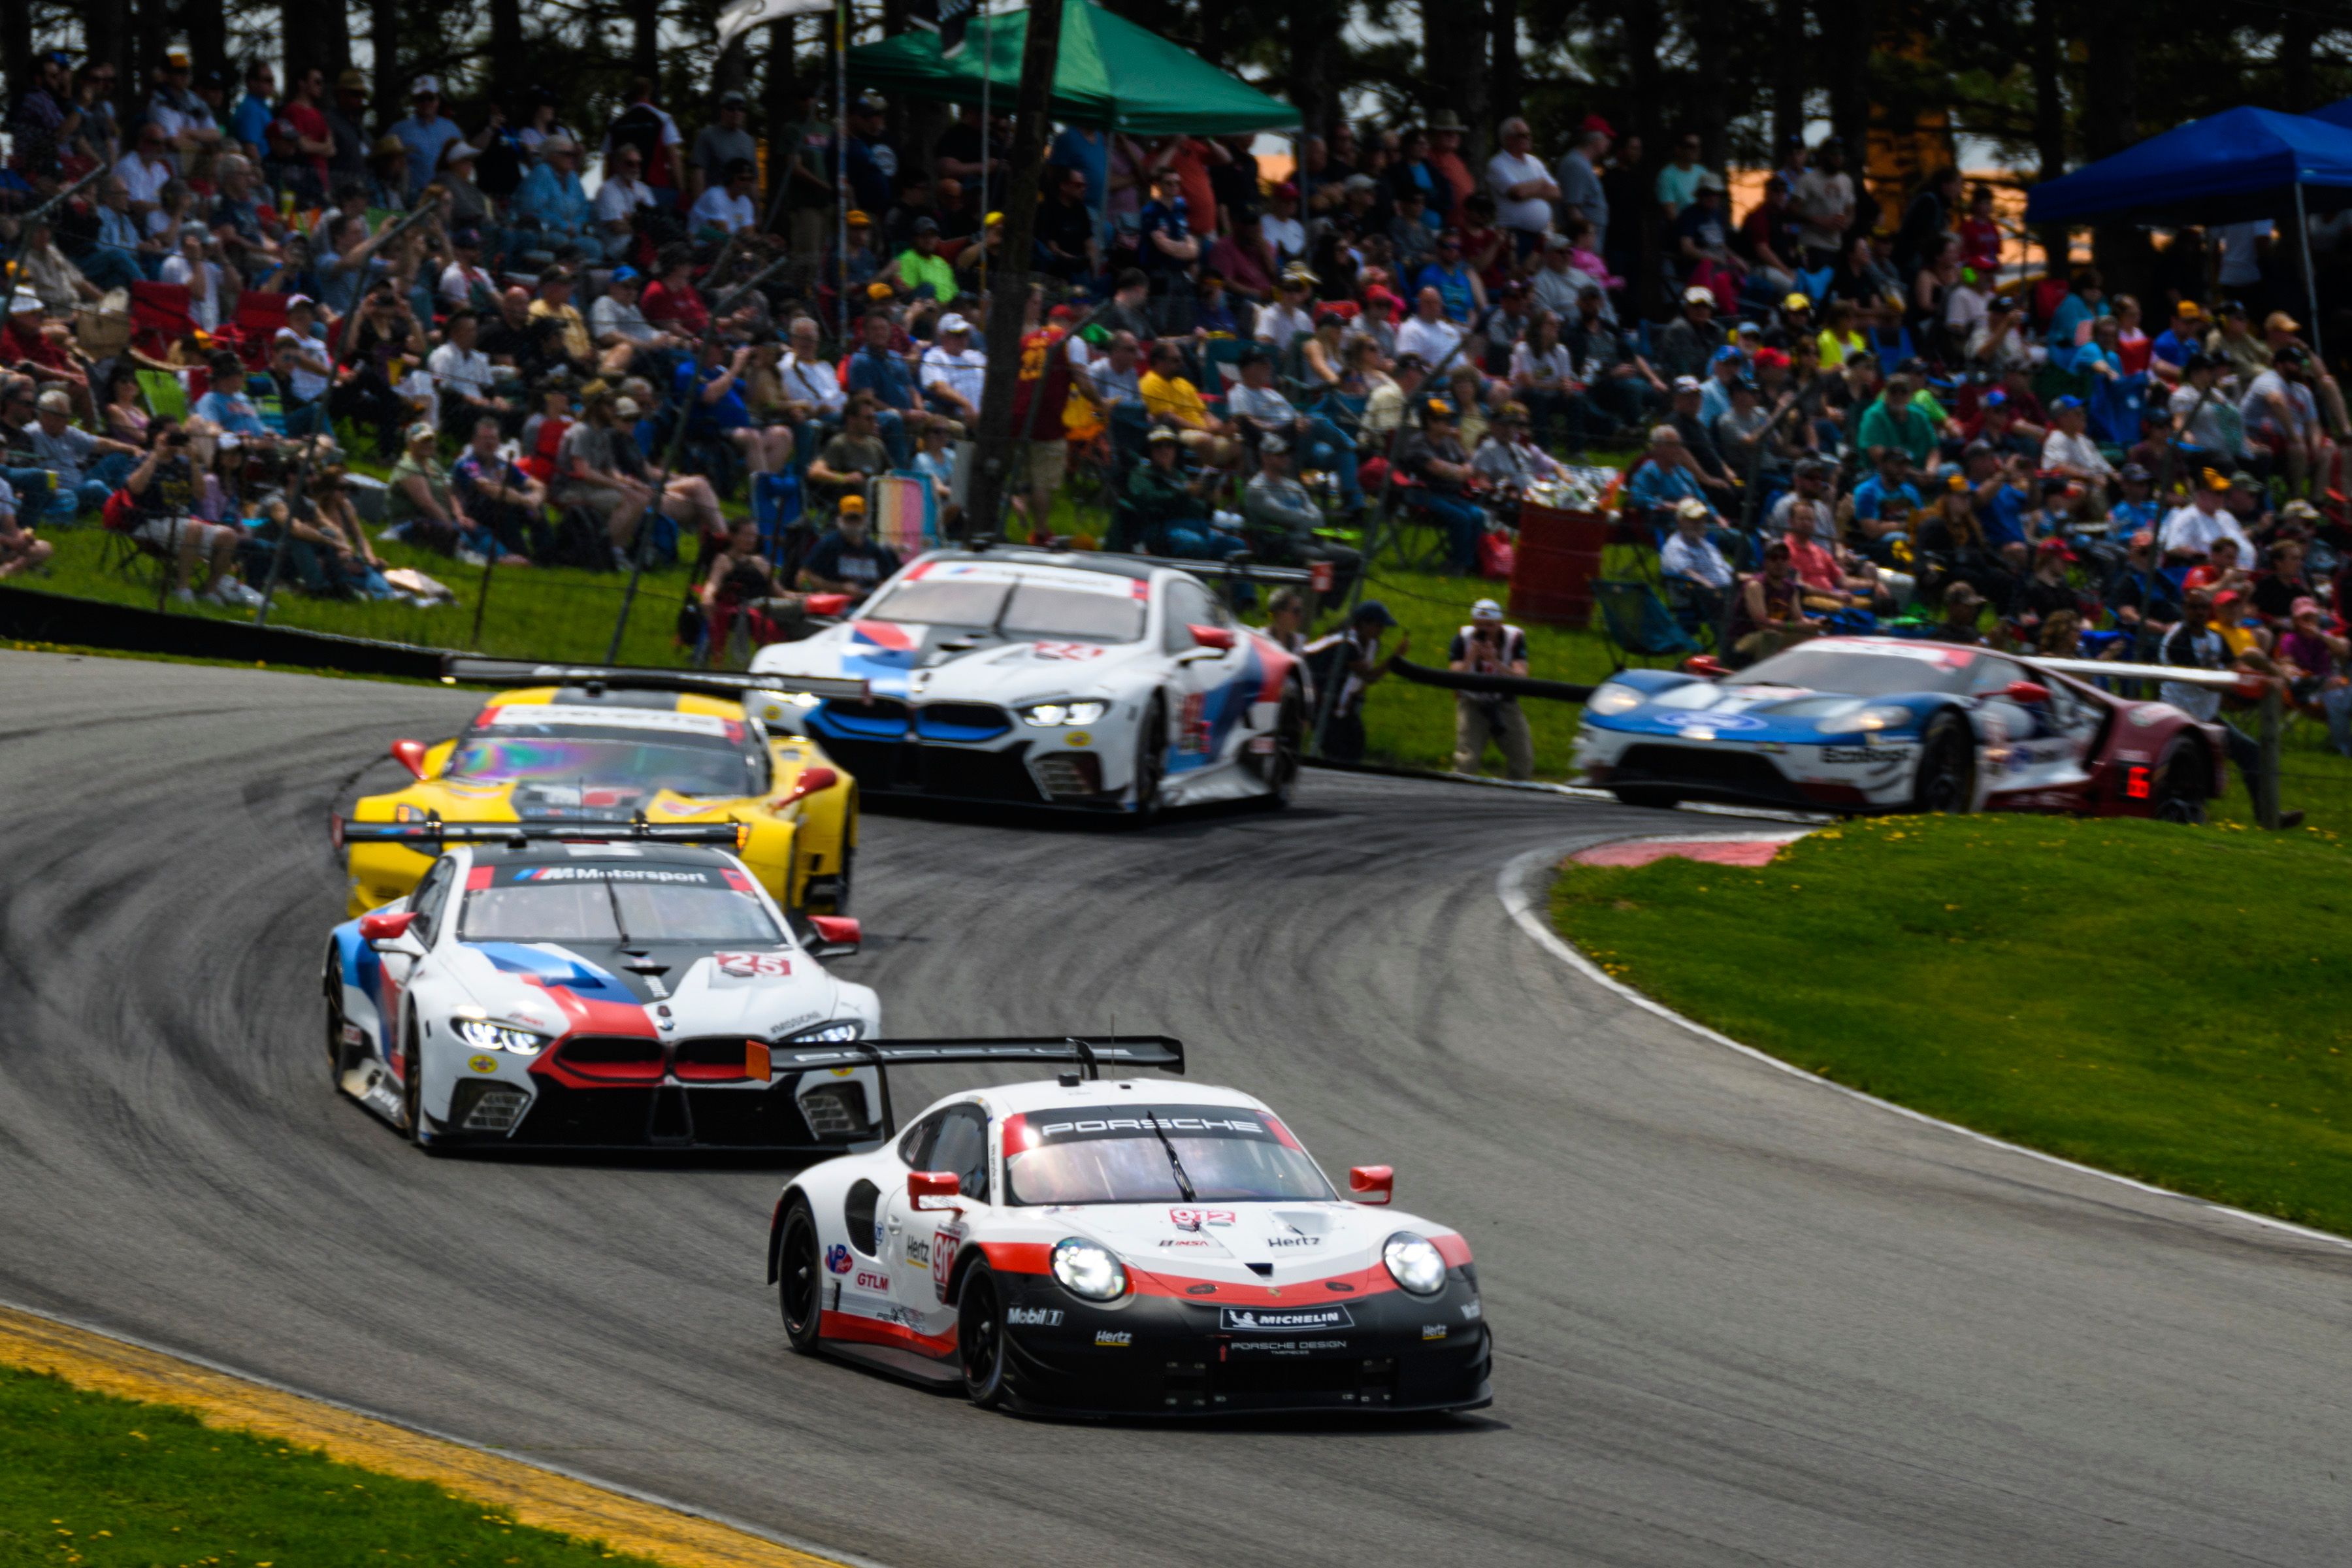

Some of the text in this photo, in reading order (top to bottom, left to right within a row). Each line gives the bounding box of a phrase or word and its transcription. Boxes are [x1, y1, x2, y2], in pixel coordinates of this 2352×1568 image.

[576, 869, 708, 883] Motorsport
[723, 954, 783, 976] 25
[1041, 1119, 1264, 1137] PORSCHE
[1173, 1209, 1229, 1225] 912
[906, 1233, 930, 1264] Hertz
[1267, 1236, 1320, 1247] Hertz
[857, 1272, 889, 1292] GTLM
[1006, 1306, 1047, 1325] Mobil
[1258, 1311, 1339, 1325] MICHELIN
[1095, 1330, 1132, 1343] Hertz
[1230, 1341, 1347, 1350] PORSCHE DESIGN
